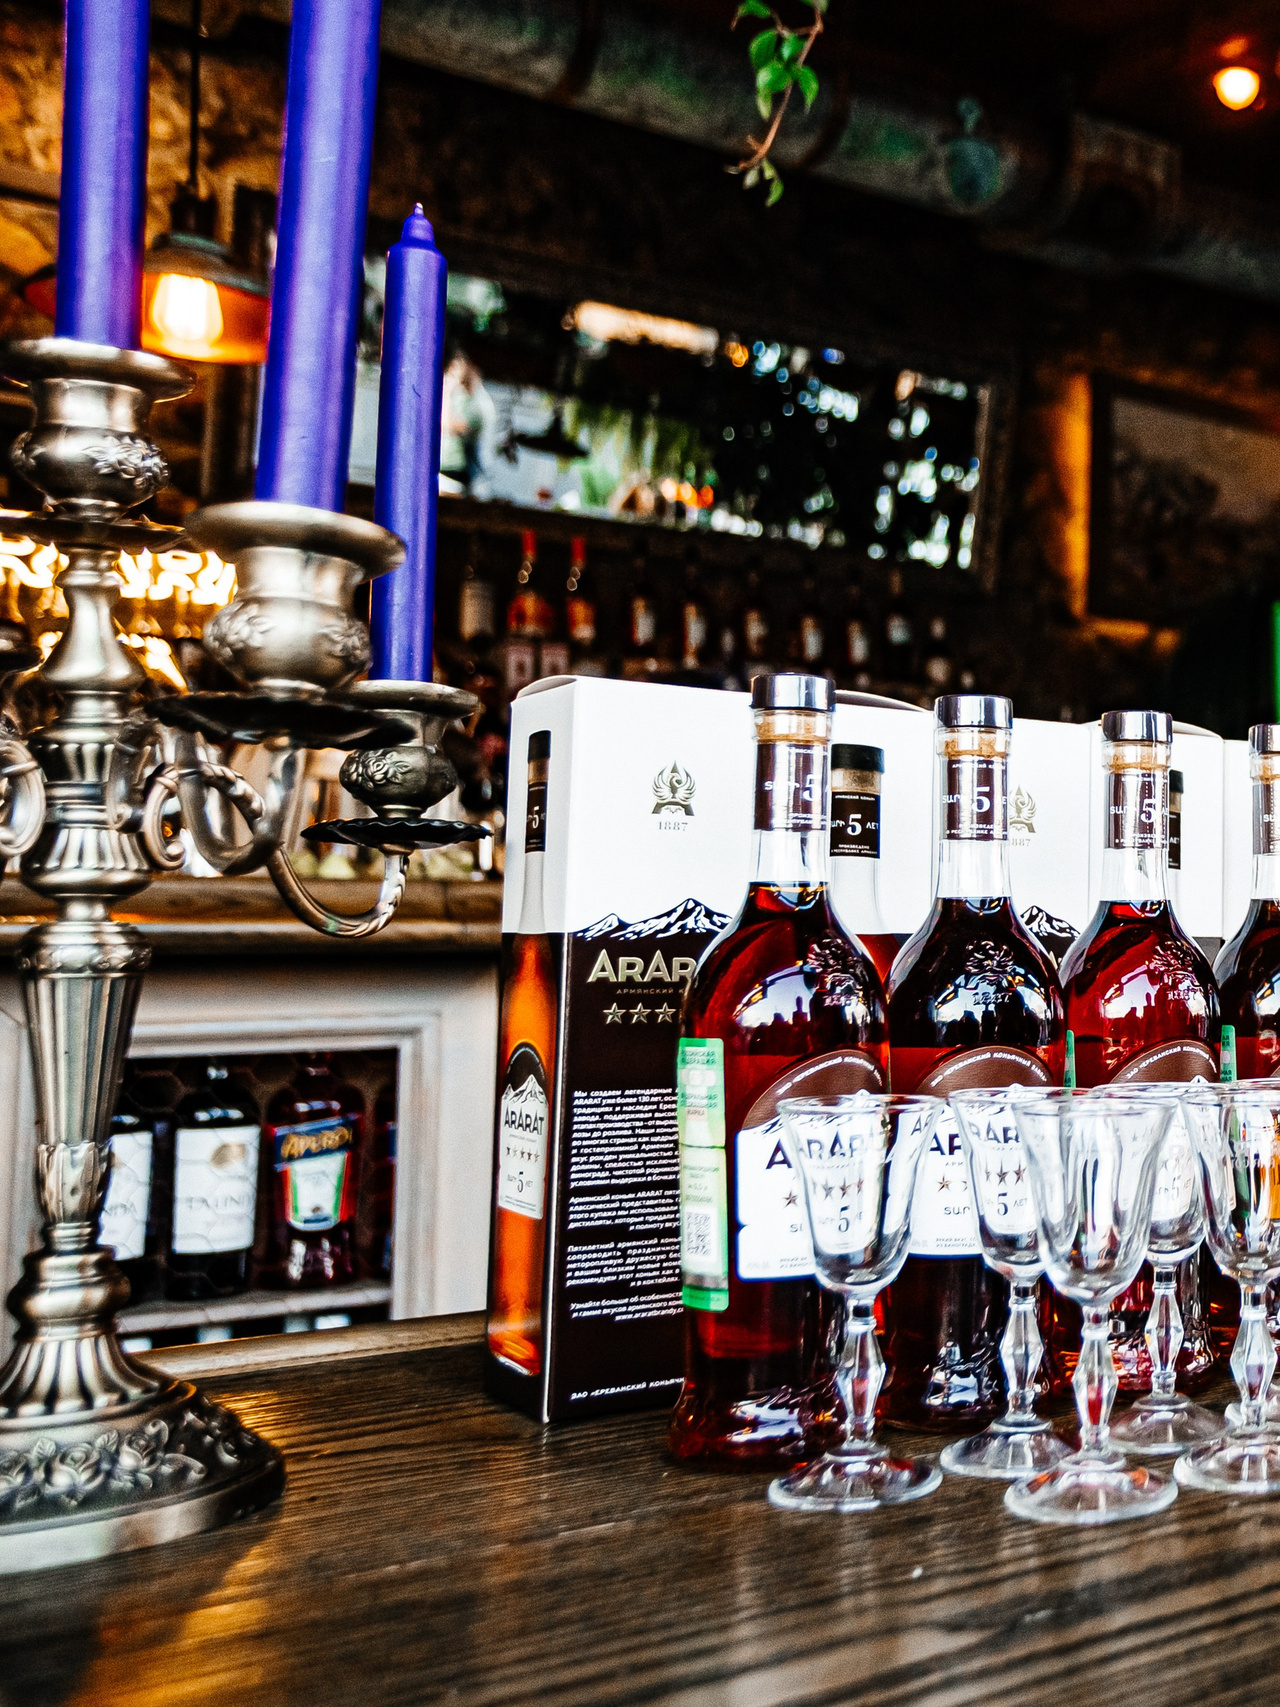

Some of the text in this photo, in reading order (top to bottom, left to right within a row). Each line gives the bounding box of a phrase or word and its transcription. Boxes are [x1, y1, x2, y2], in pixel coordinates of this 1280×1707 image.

[971, 786, 990, 812] 5
[1141, 799, 1157, 822] 5
[658, 821, 688, 831] 1887
[847, 814, 861, 835] 5
[993, 1052, 1031, 1067] КОНЬЯЧНЫЙ
[1126, 1067, 1139, 1079] ЗАО
[624, 1088, 672, 1096] легендарные
[504, 1106, 544, 1135] ARARAT
[610, 1137, 637, 1145] странах
[580, 1144, 638, 1153] гостеприимной
[619, 1151, 673, 1160] уникальностью
[570, 1164, 602, 1172] долины,
[570, 1171, 611, 1179] винограда,
[518, 1171, 523, 1193] 5
[570, 1180, 610, 1189] условиями
[611, 1176, 646, 1184] выдержки
[569, 1194, 610, 1204] Армянский
[637, 1190, 663, 1198] ARARAT
[569, 1199, 673, 1211] классический представитель
[630, 1206, 678, 1214] использовали
[997, 1192, 1009, 1216] 5
[838, 1206, 850, 1233] 5
[567, 1238, 658, 1252] Пятилетний армянский
[567, 1245, 679, 1260] сопроводить праздничное
[566, 1259, 624, 1269] неторопливую
[625, 1254, 666, 1264] дружескую
[565, 1275, 617, 1287] рекомендуем
[642, 1277, 680, 1285] коктейлях.
[570, 1301, 601, 1310] Узнайте
[601, 1298, 629, 1306] больше
[602, 1307, 626, 1315] вкусов
[628, 1301, 667, 1311] армянского
[570, 1392, 588, 1400] ЗАО
